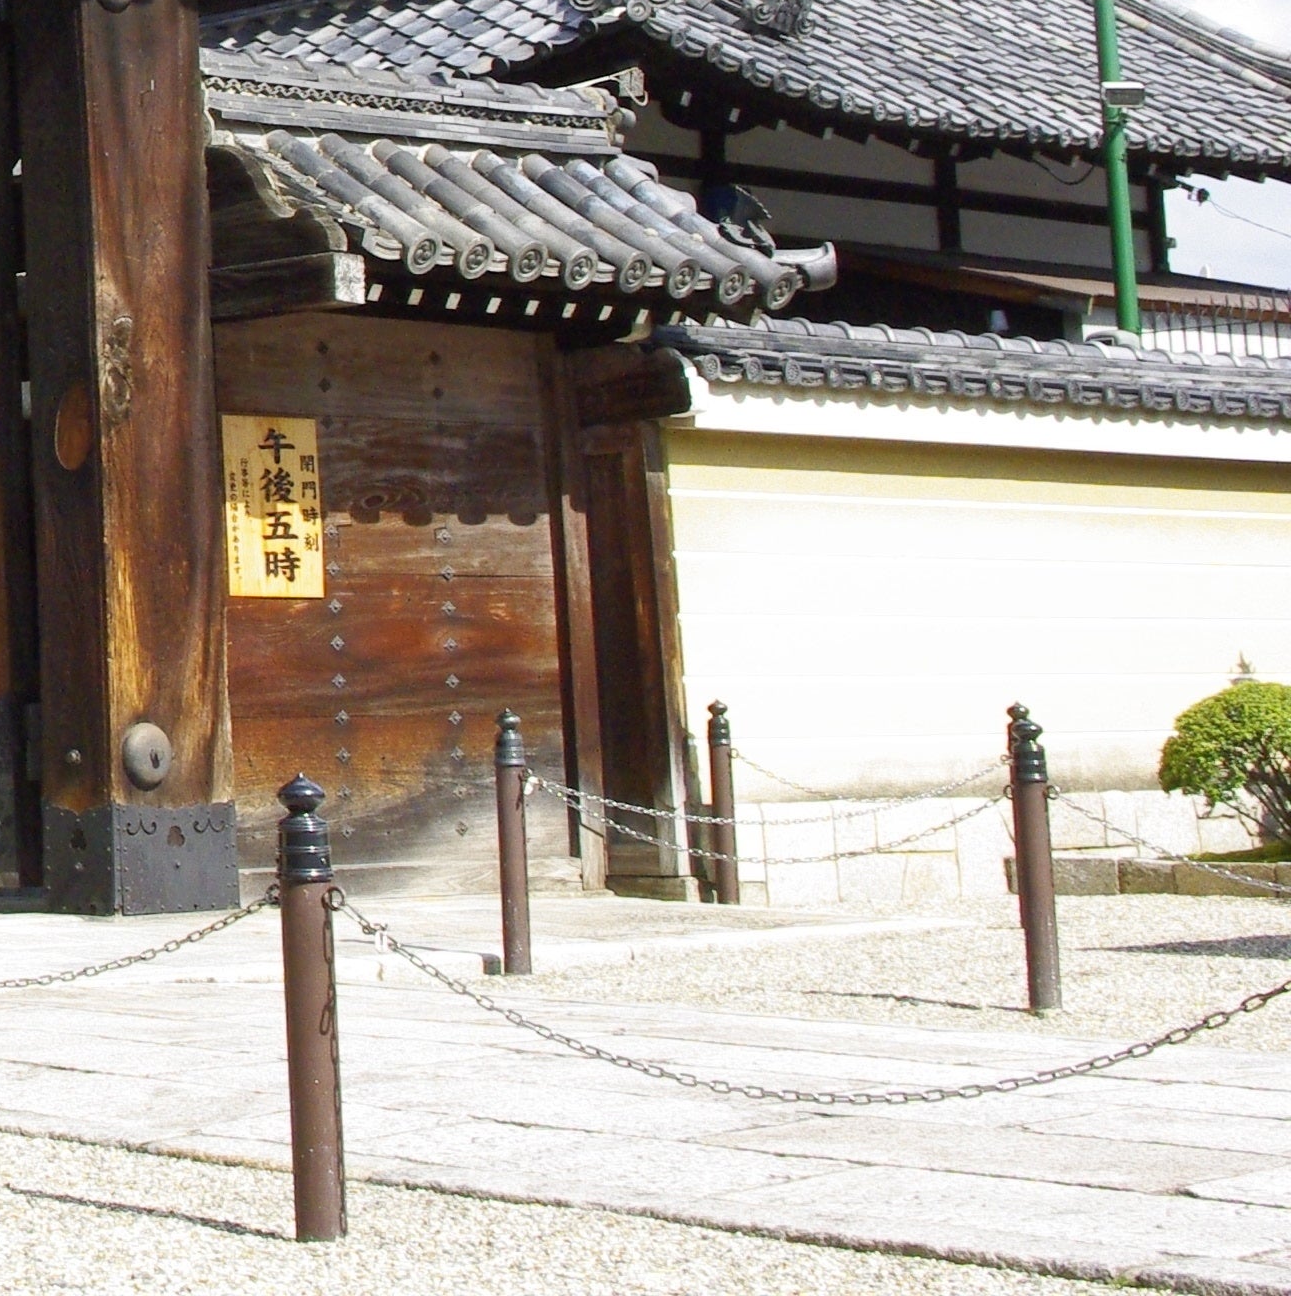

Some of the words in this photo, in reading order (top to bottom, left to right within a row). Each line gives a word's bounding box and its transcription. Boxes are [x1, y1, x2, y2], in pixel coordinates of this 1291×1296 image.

[258, 428, 301, 582] 午後五時
[300, 455, 319, 552] 閉門時刻
